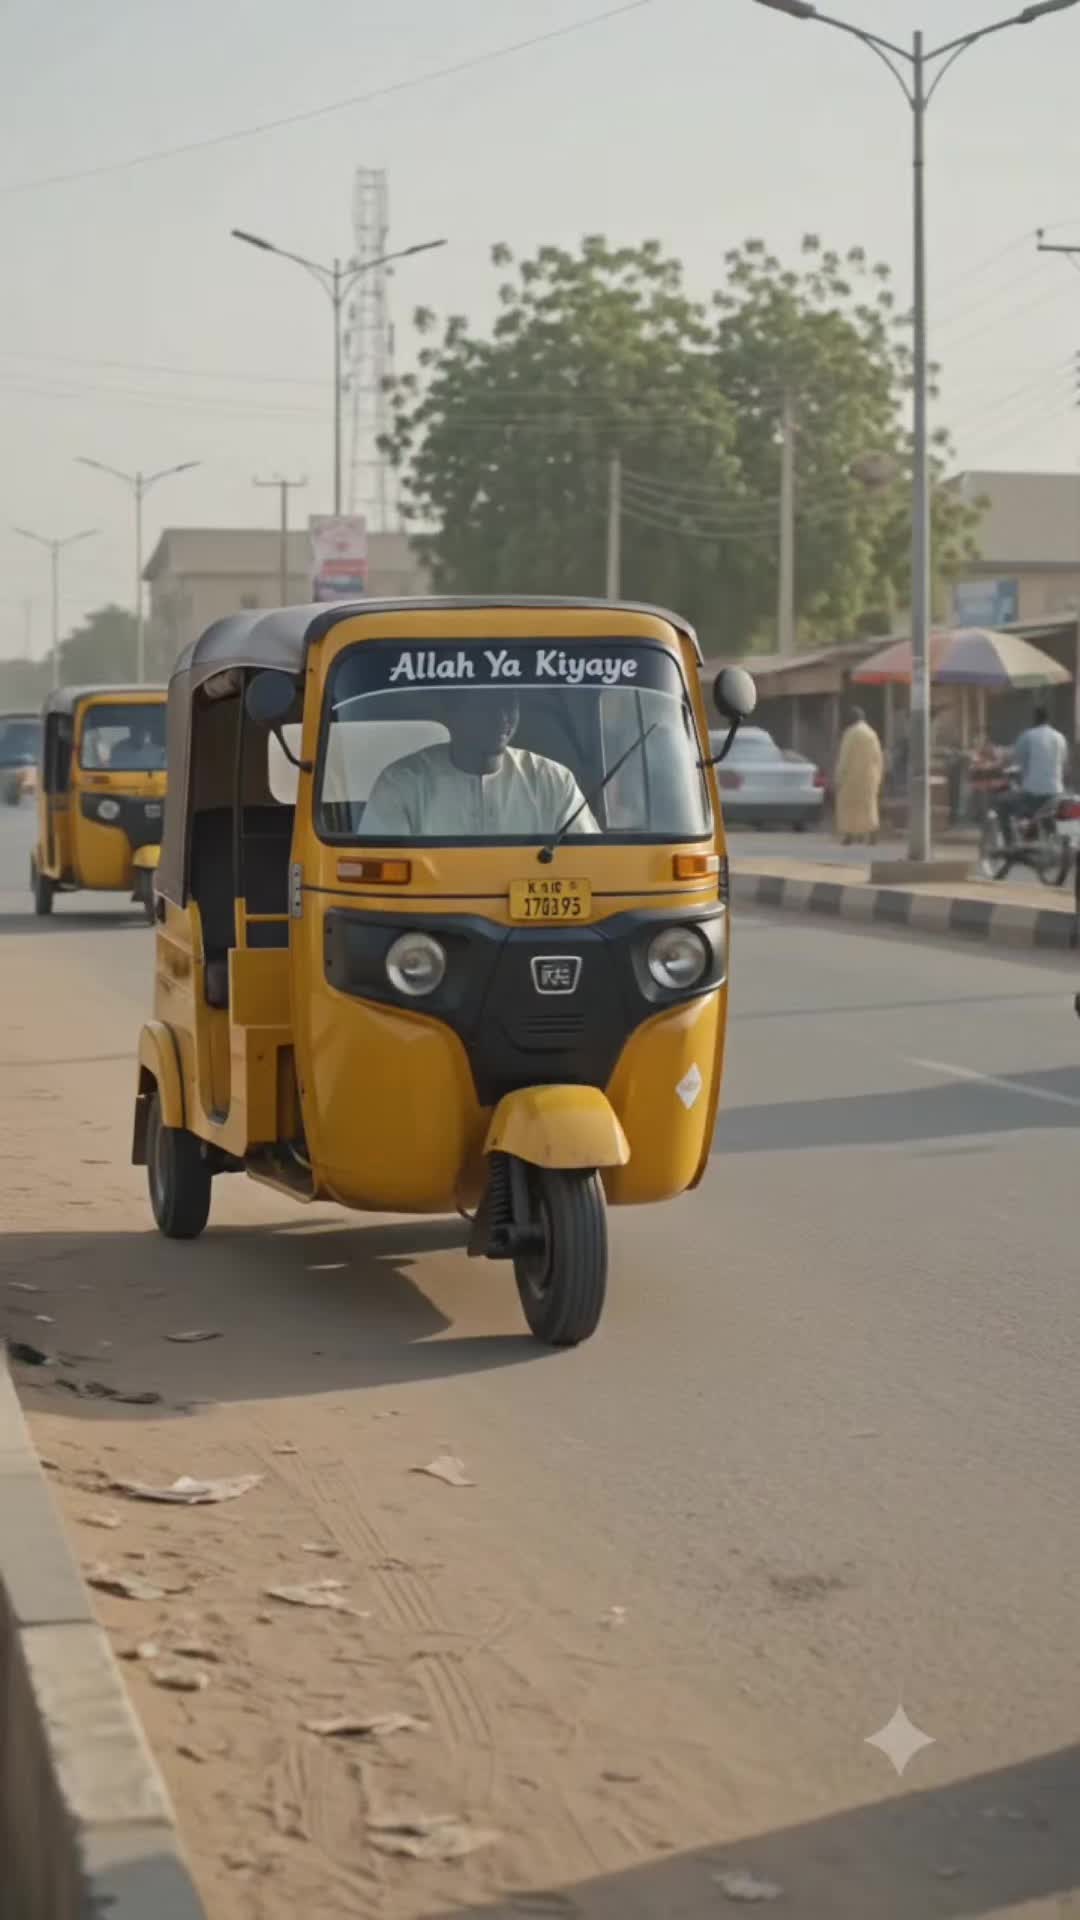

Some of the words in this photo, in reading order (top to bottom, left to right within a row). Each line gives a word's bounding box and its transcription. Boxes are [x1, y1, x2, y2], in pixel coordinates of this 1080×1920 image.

[389, 652, 475, 681] Allah
[485, 650, 521, 678] Ya
[535, 650, 638, 683] Kiyaye
